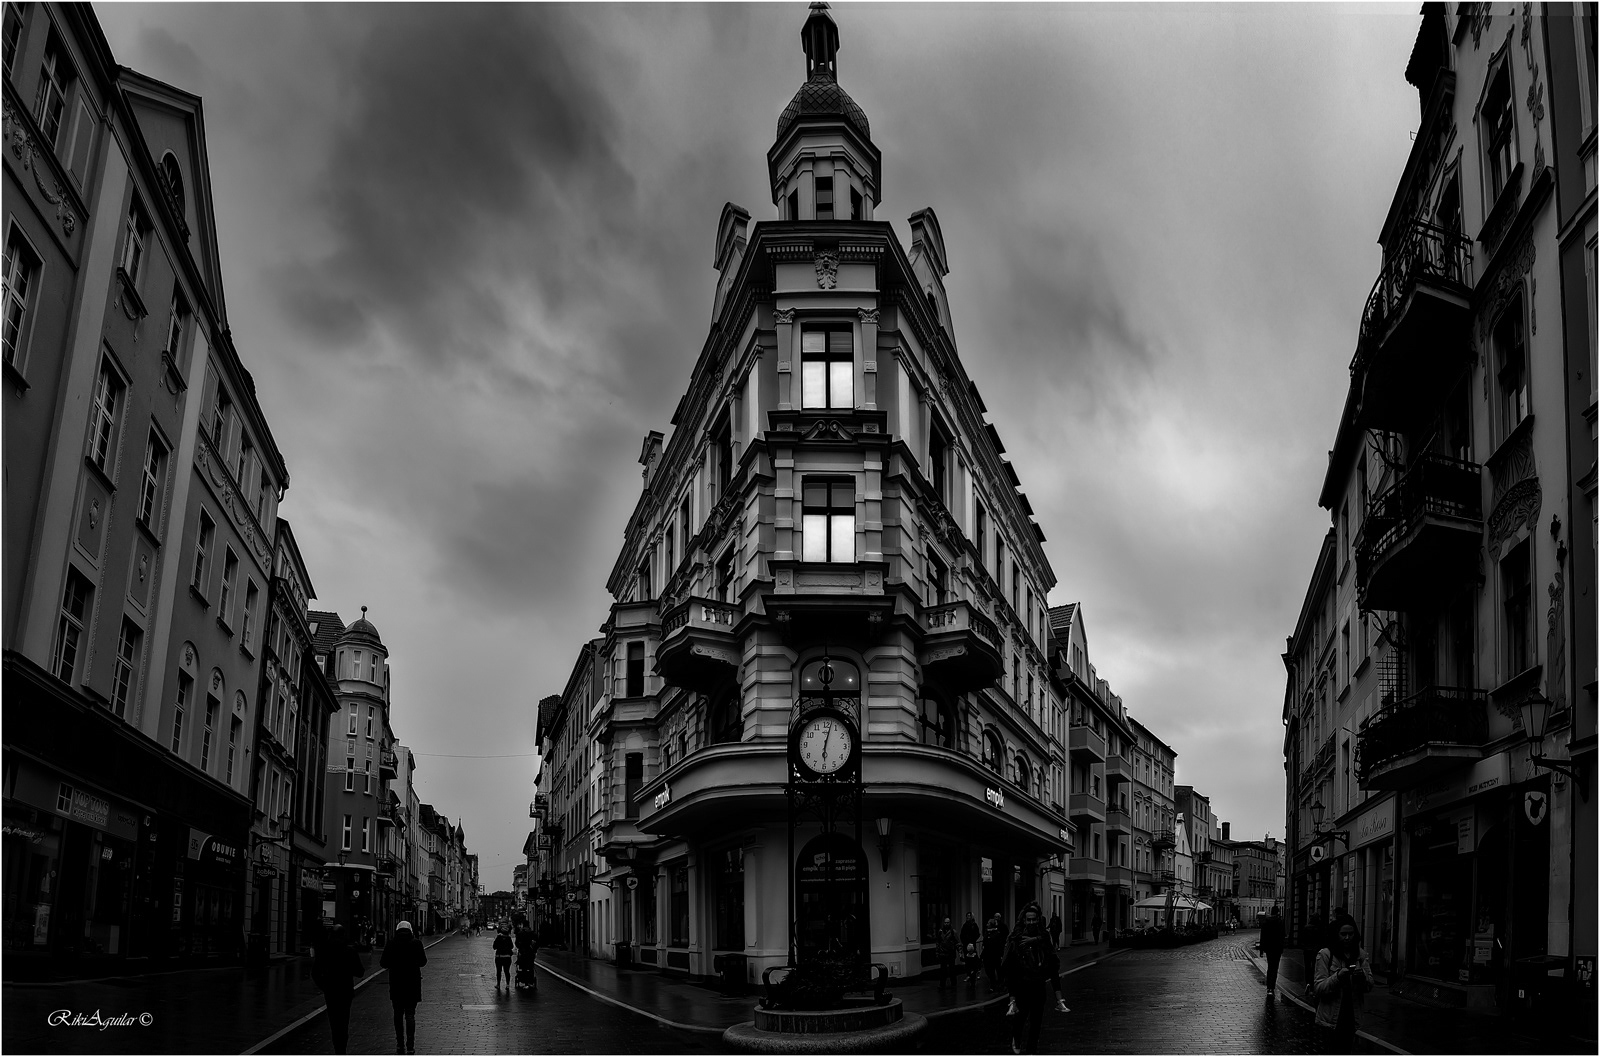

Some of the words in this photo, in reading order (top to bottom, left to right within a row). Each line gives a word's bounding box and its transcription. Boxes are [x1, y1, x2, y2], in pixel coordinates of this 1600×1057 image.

[74, 788, 91, 808] TOP
[91, 795, 110, 816] TOYS
[654, 782, 670, 809] empik
[986, 787, 1005, 808] empik
[211, 841, 236, 858] OBUWIE
